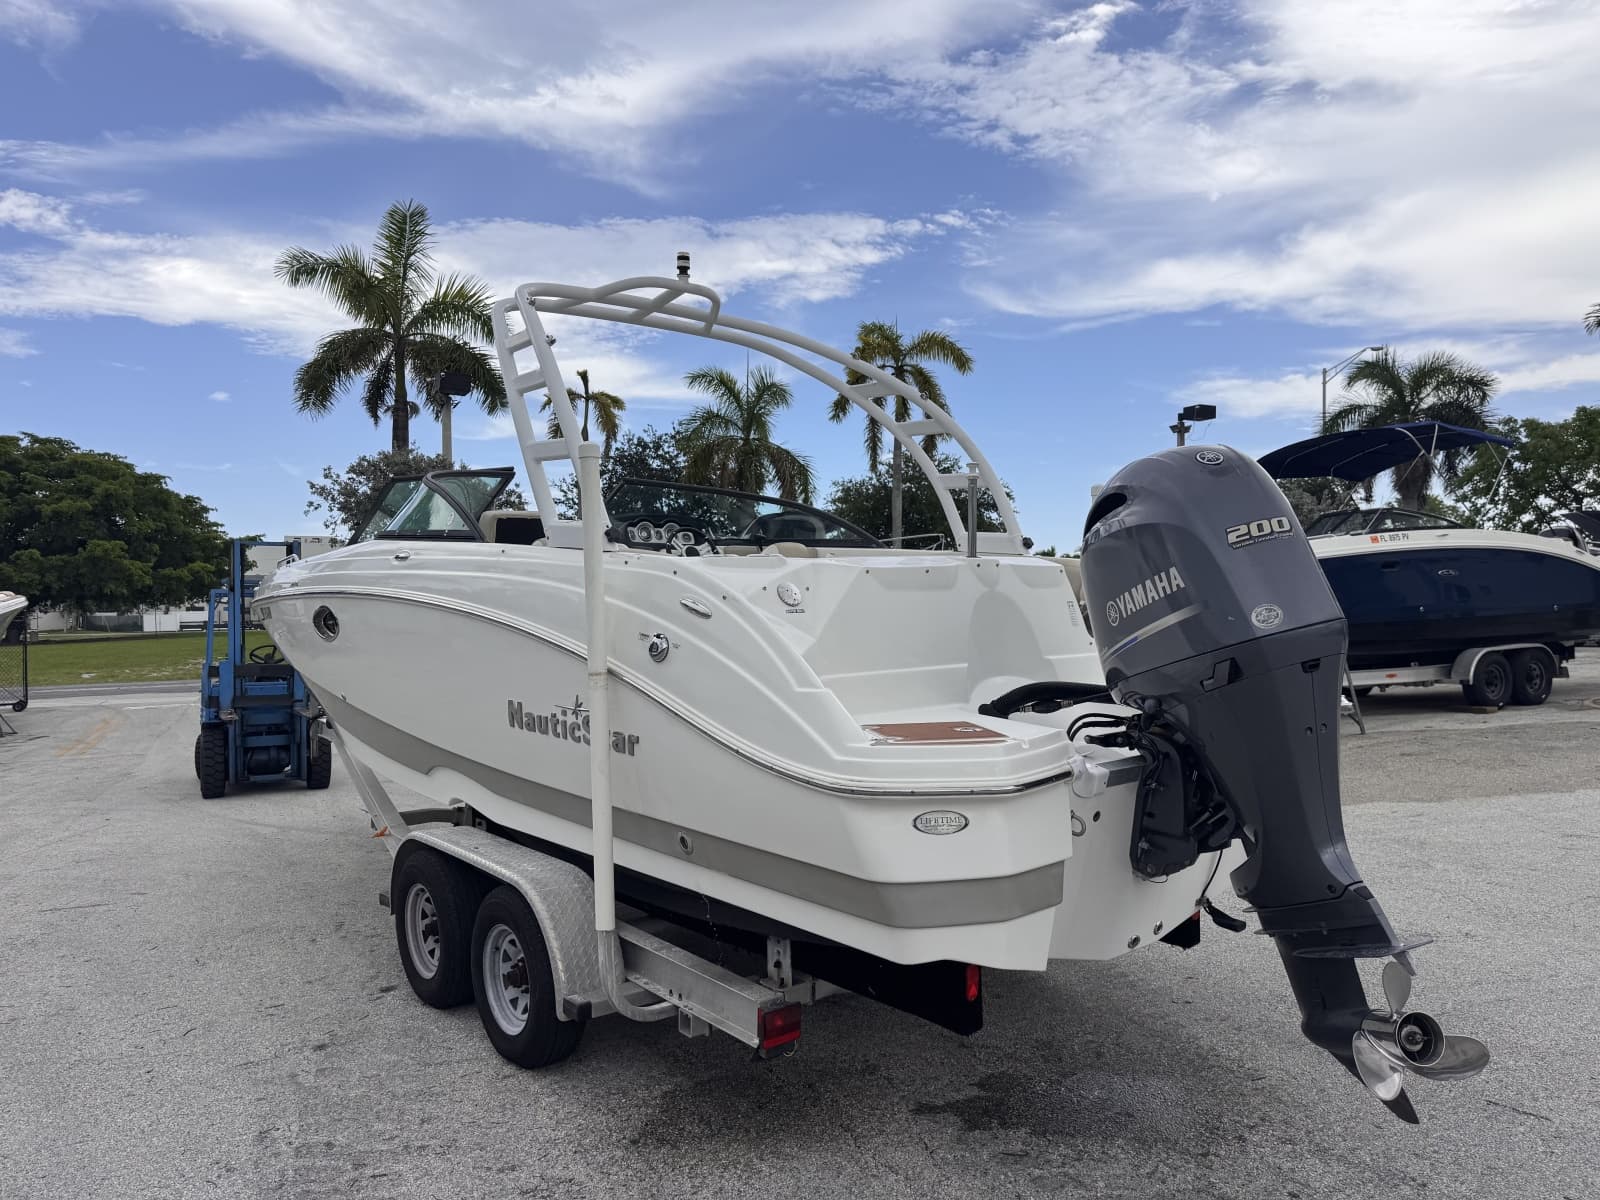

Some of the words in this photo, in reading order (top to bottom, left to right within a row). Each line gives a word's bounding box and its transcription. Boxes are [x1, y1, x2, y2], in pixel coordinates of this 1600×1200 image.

[1226, 516, 1291, 544] 200
[1115, 566, 1185, 619] YAMAHA
[507, 699, 640, 757] NauticSar
